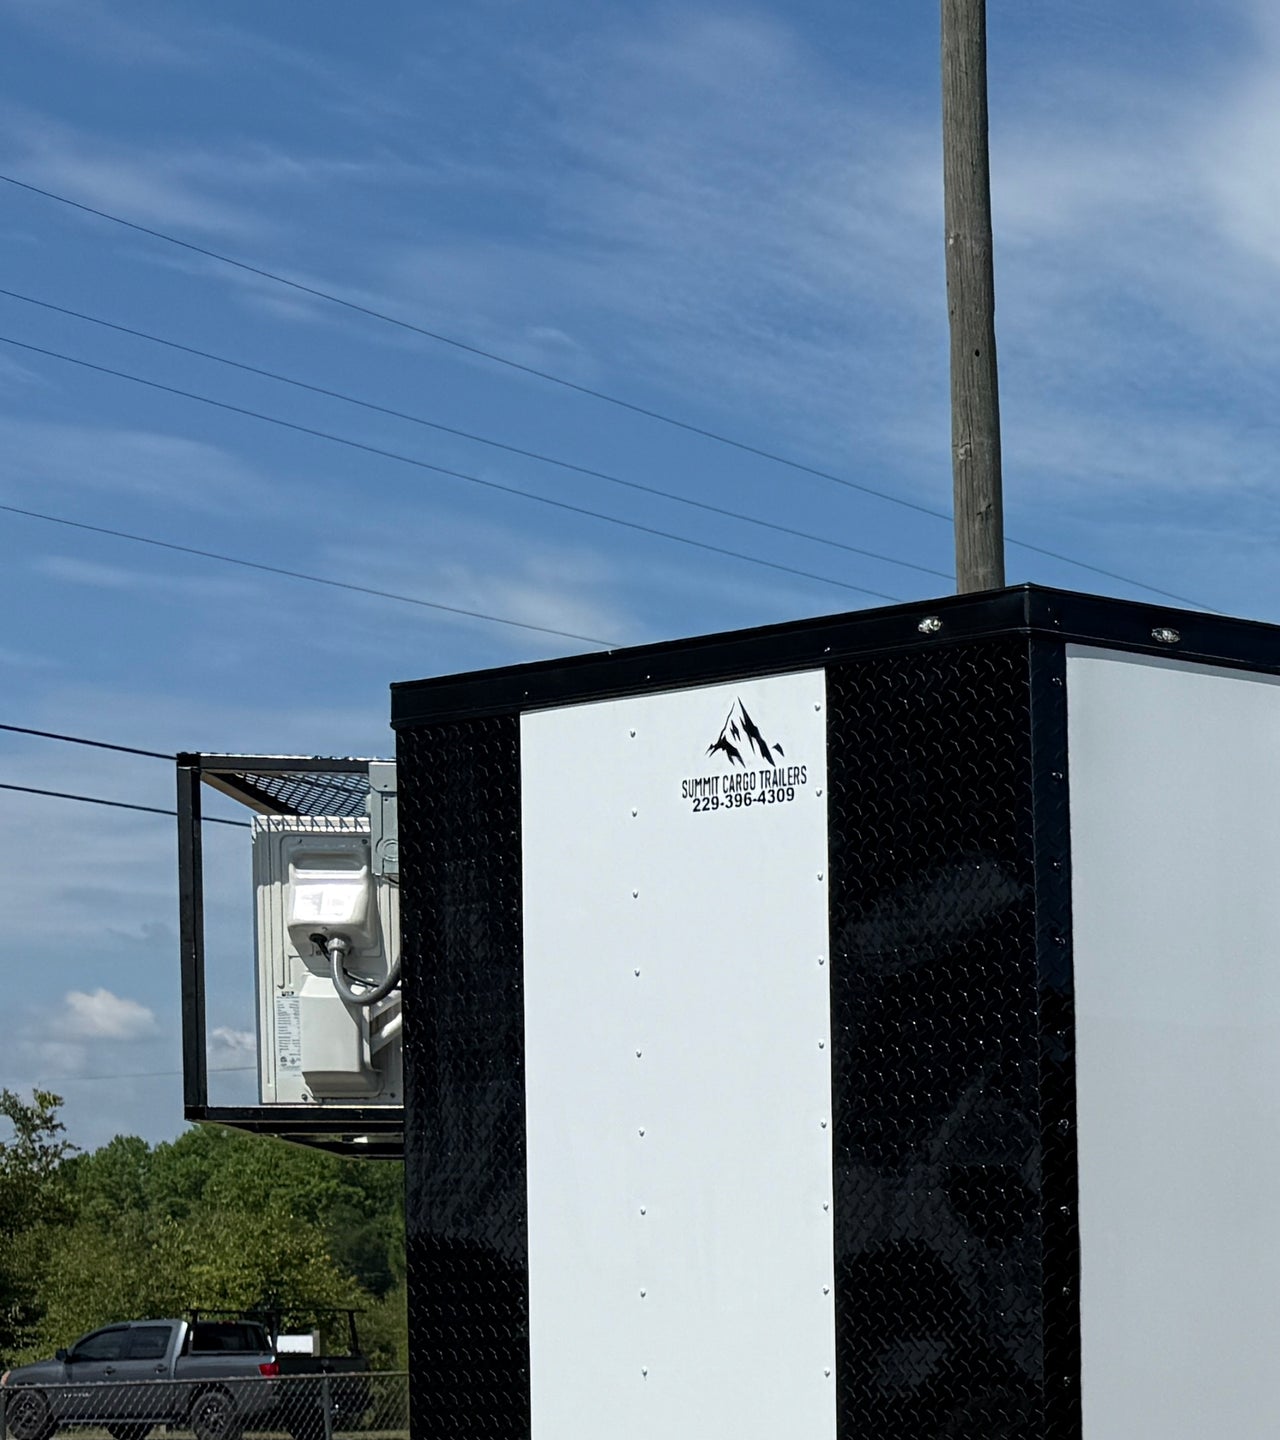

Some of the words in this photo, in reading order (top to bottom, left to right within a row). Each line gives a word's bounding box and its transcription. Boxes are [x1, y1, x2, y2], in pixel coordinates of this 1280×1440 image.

[682, 776, 720, 799] SUMMIT
[723, 771, 756, 794] CARGO
[759, 765, 807, 789] TRAILERS
[692, 787, 795, 813] 229-396-4309
